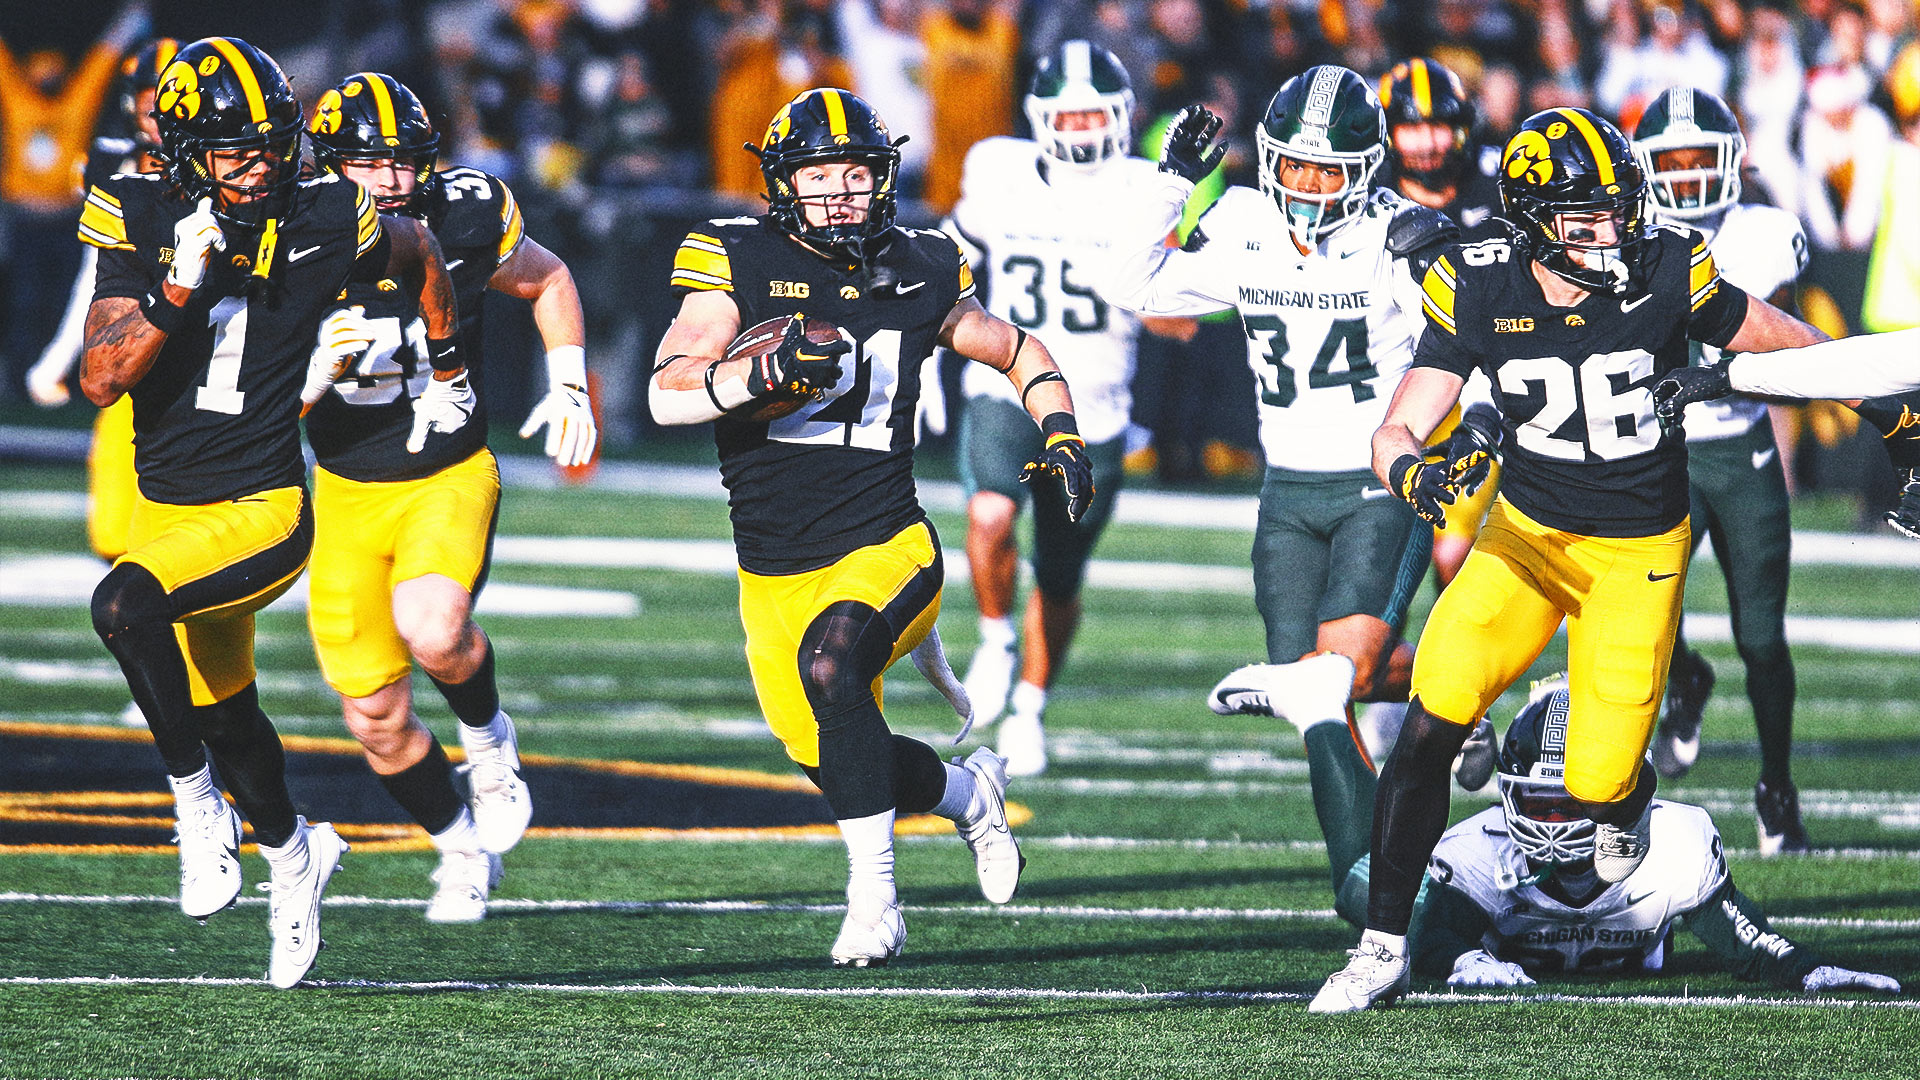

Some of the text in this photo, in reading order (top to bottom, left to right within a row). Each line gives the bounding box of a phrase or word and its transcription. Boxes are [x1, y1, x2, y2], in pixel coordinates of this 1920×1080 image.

[1003, 254, 1109, 334] 35
[1238, 285, 1372, 310] MICHIGAN STATE
[195, 296, 248, 415] 1
[767, 326, 903, 452] 21
[1243, 314, 1380, 408] 34
[1496, 348, 1662, 462] 26
[1541, 767, 1564, 778] STATE
[1518, 927, 1595, 944] CHIGAN
